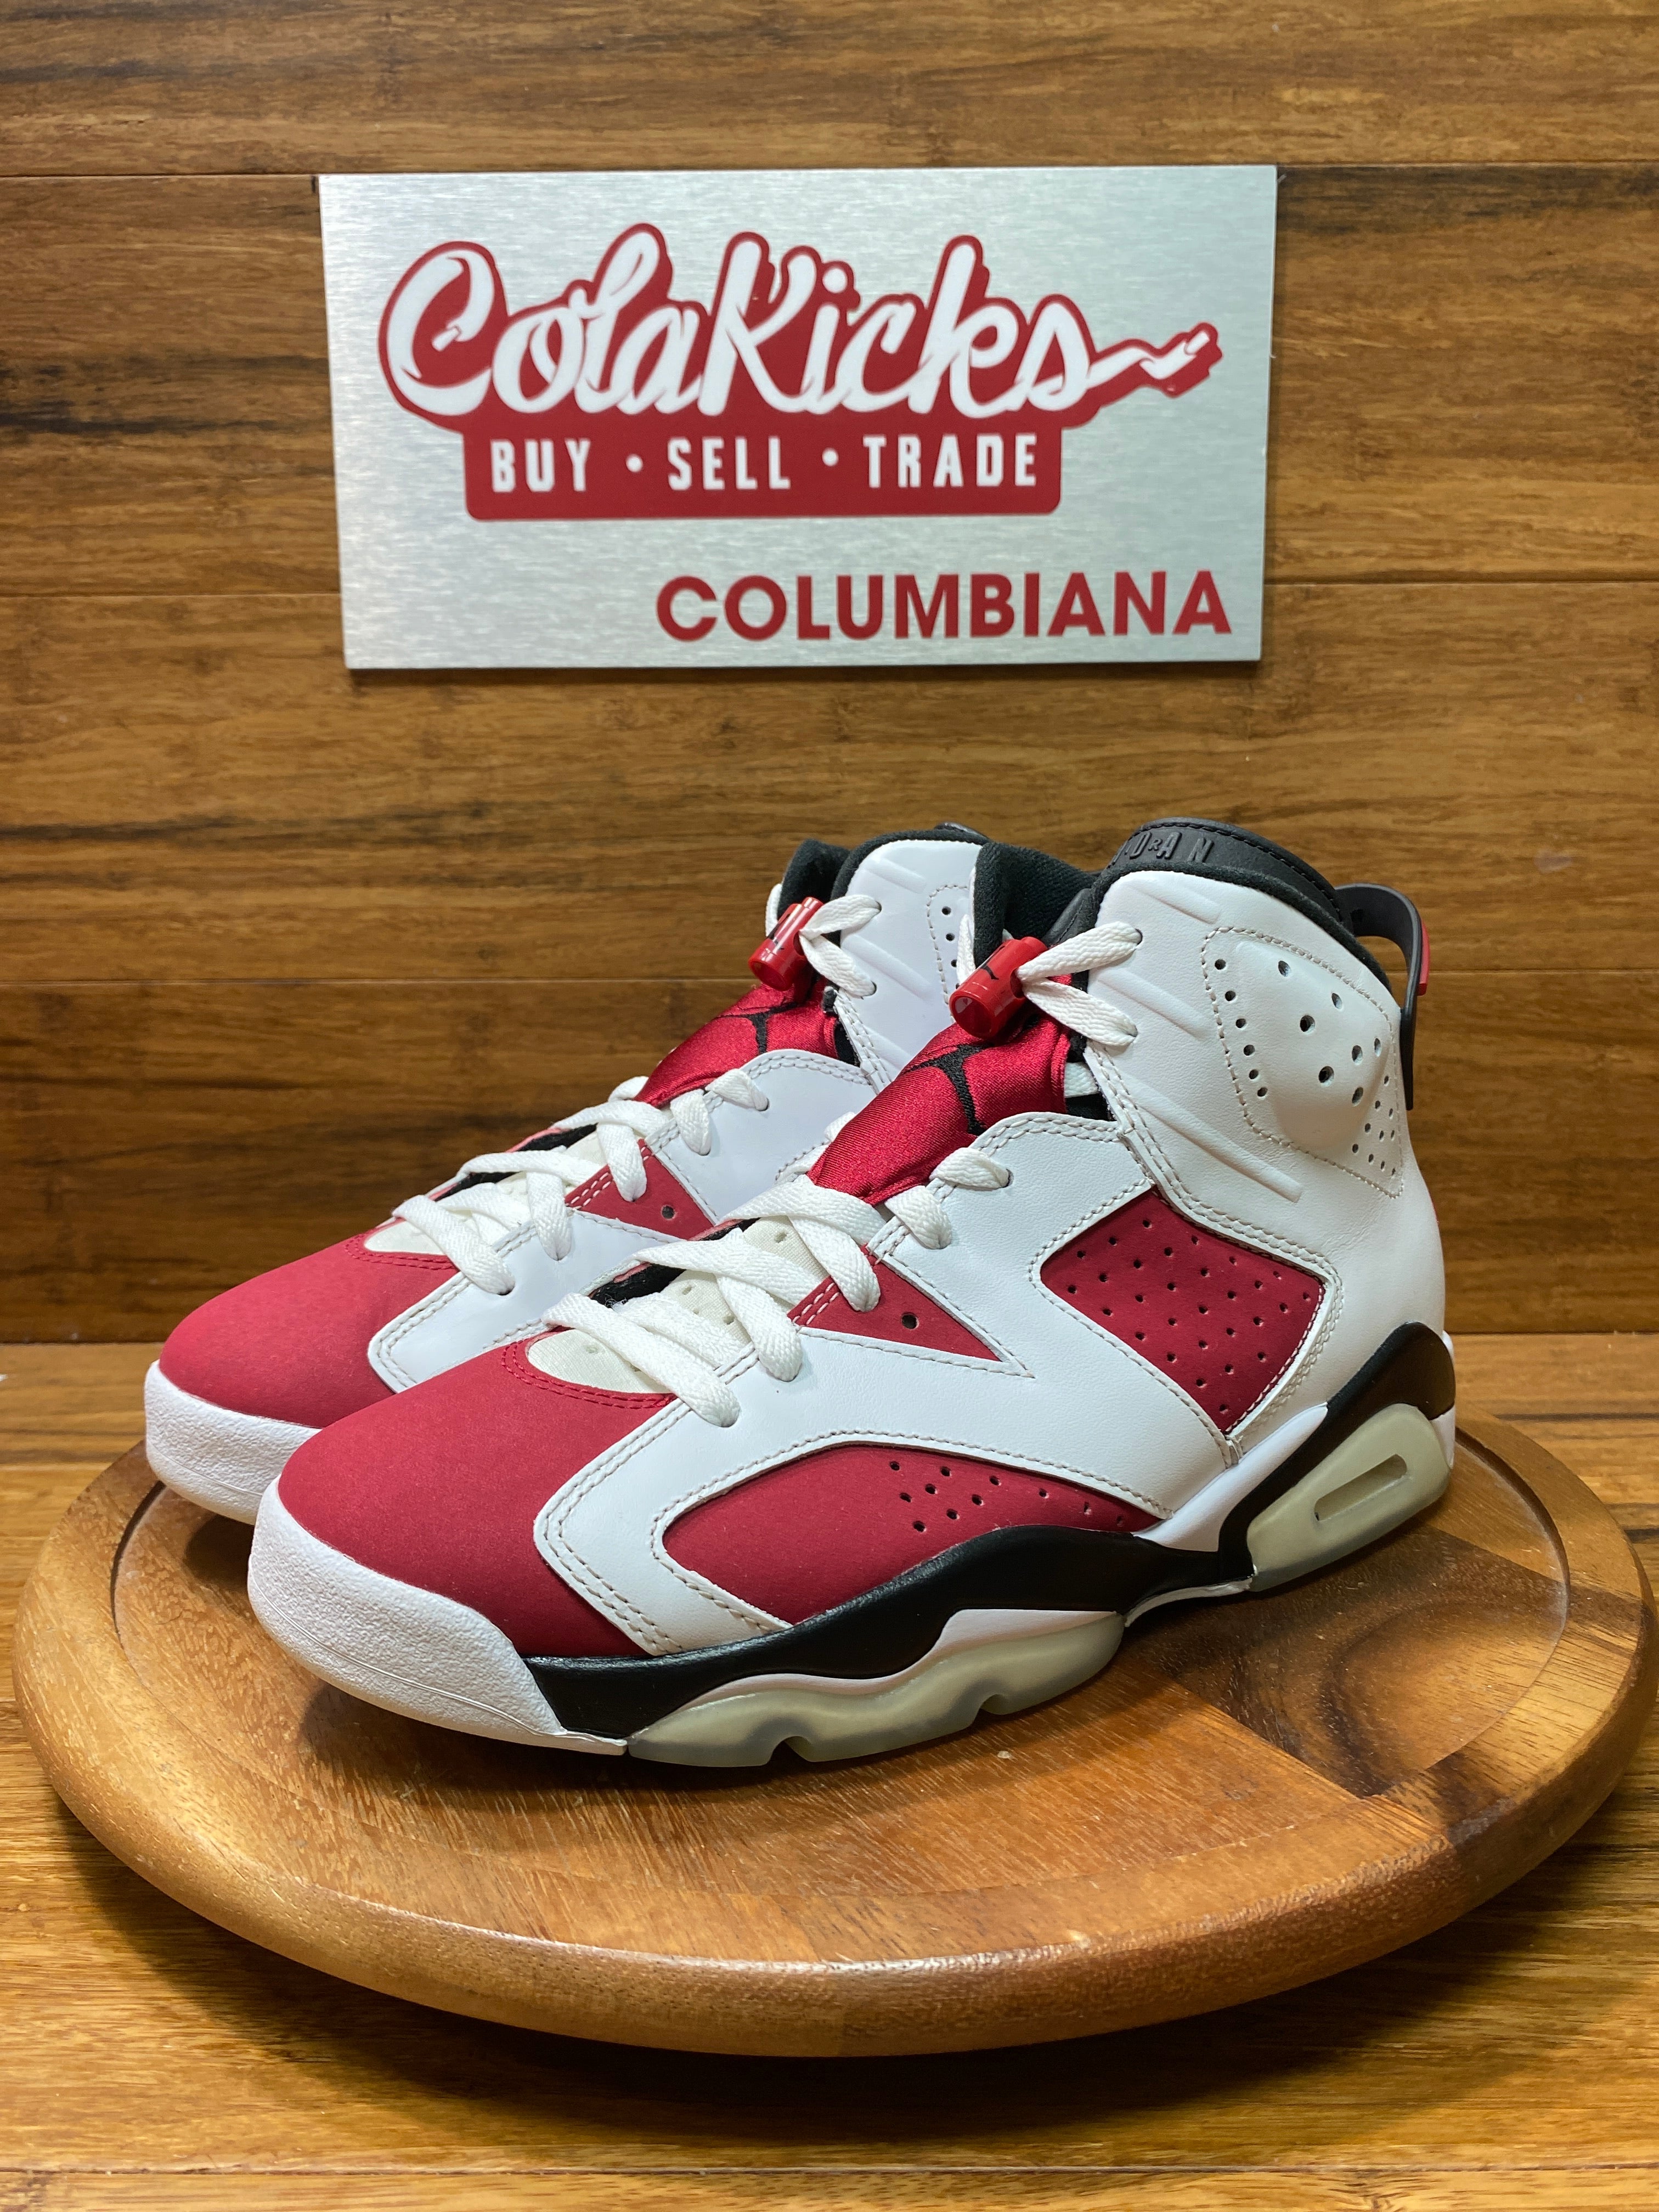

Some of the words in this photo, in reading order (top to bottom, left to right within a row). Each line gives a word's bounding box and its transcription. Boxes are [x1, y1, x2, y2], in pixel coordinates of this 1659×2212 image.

[491, 440, 590, 492] BUY
[668, 437, 790, 490] SELL
[863, 434, 1036, 488] TRADE
[657, 571, 1230, 640] COLUMBIANA
